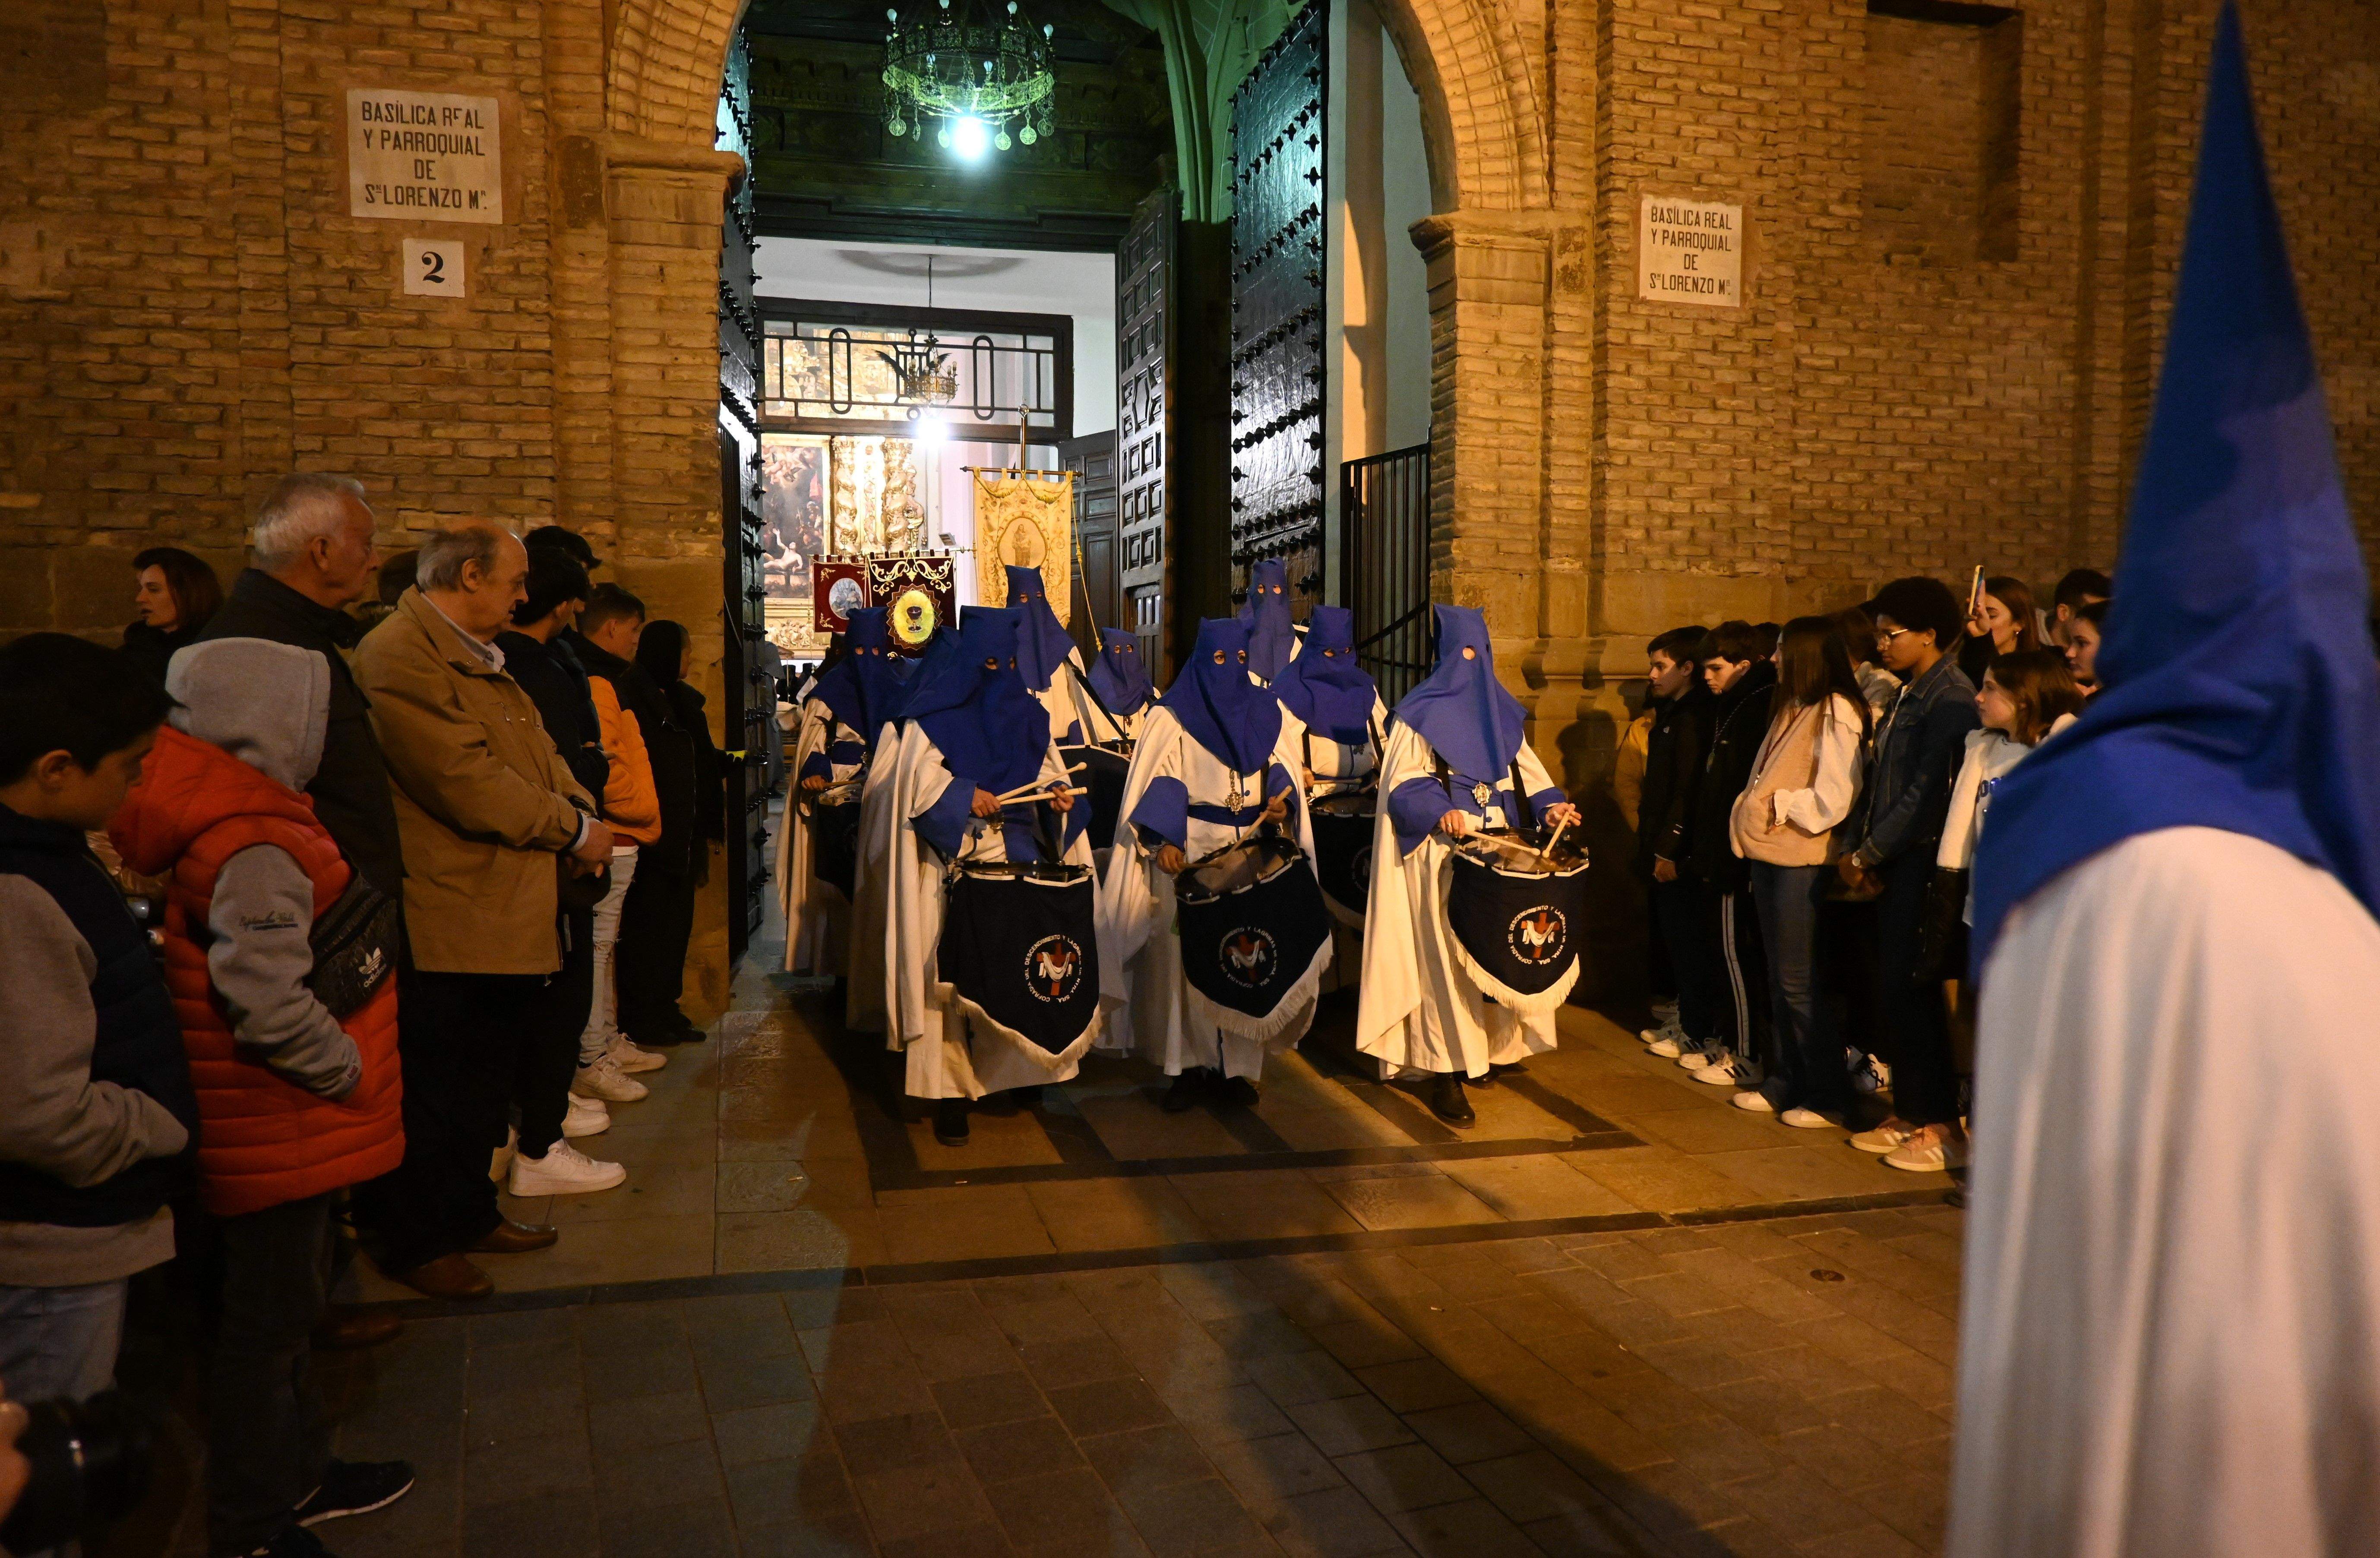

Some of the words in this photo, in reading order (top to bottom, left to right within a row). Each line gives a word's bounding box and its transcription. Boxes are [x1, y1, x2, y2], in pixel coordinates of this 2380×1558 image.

[362, 100, 436, 126] BASÍLICA
[443, 107, 484, 129] REAL
[363, 129, 373, 149] Y
[381, 129, 485, 157] PARROQUIAL
[414, 159, 436, 180] DE
[1705, 211, 1732, 230] REAL
[1651, 228, 1657, 244] Y
[1662, 230, 1731, 252] PARROQUIAL
[421, 251, 445, 284] 2
[1684, 254, 1698, 270] DE
